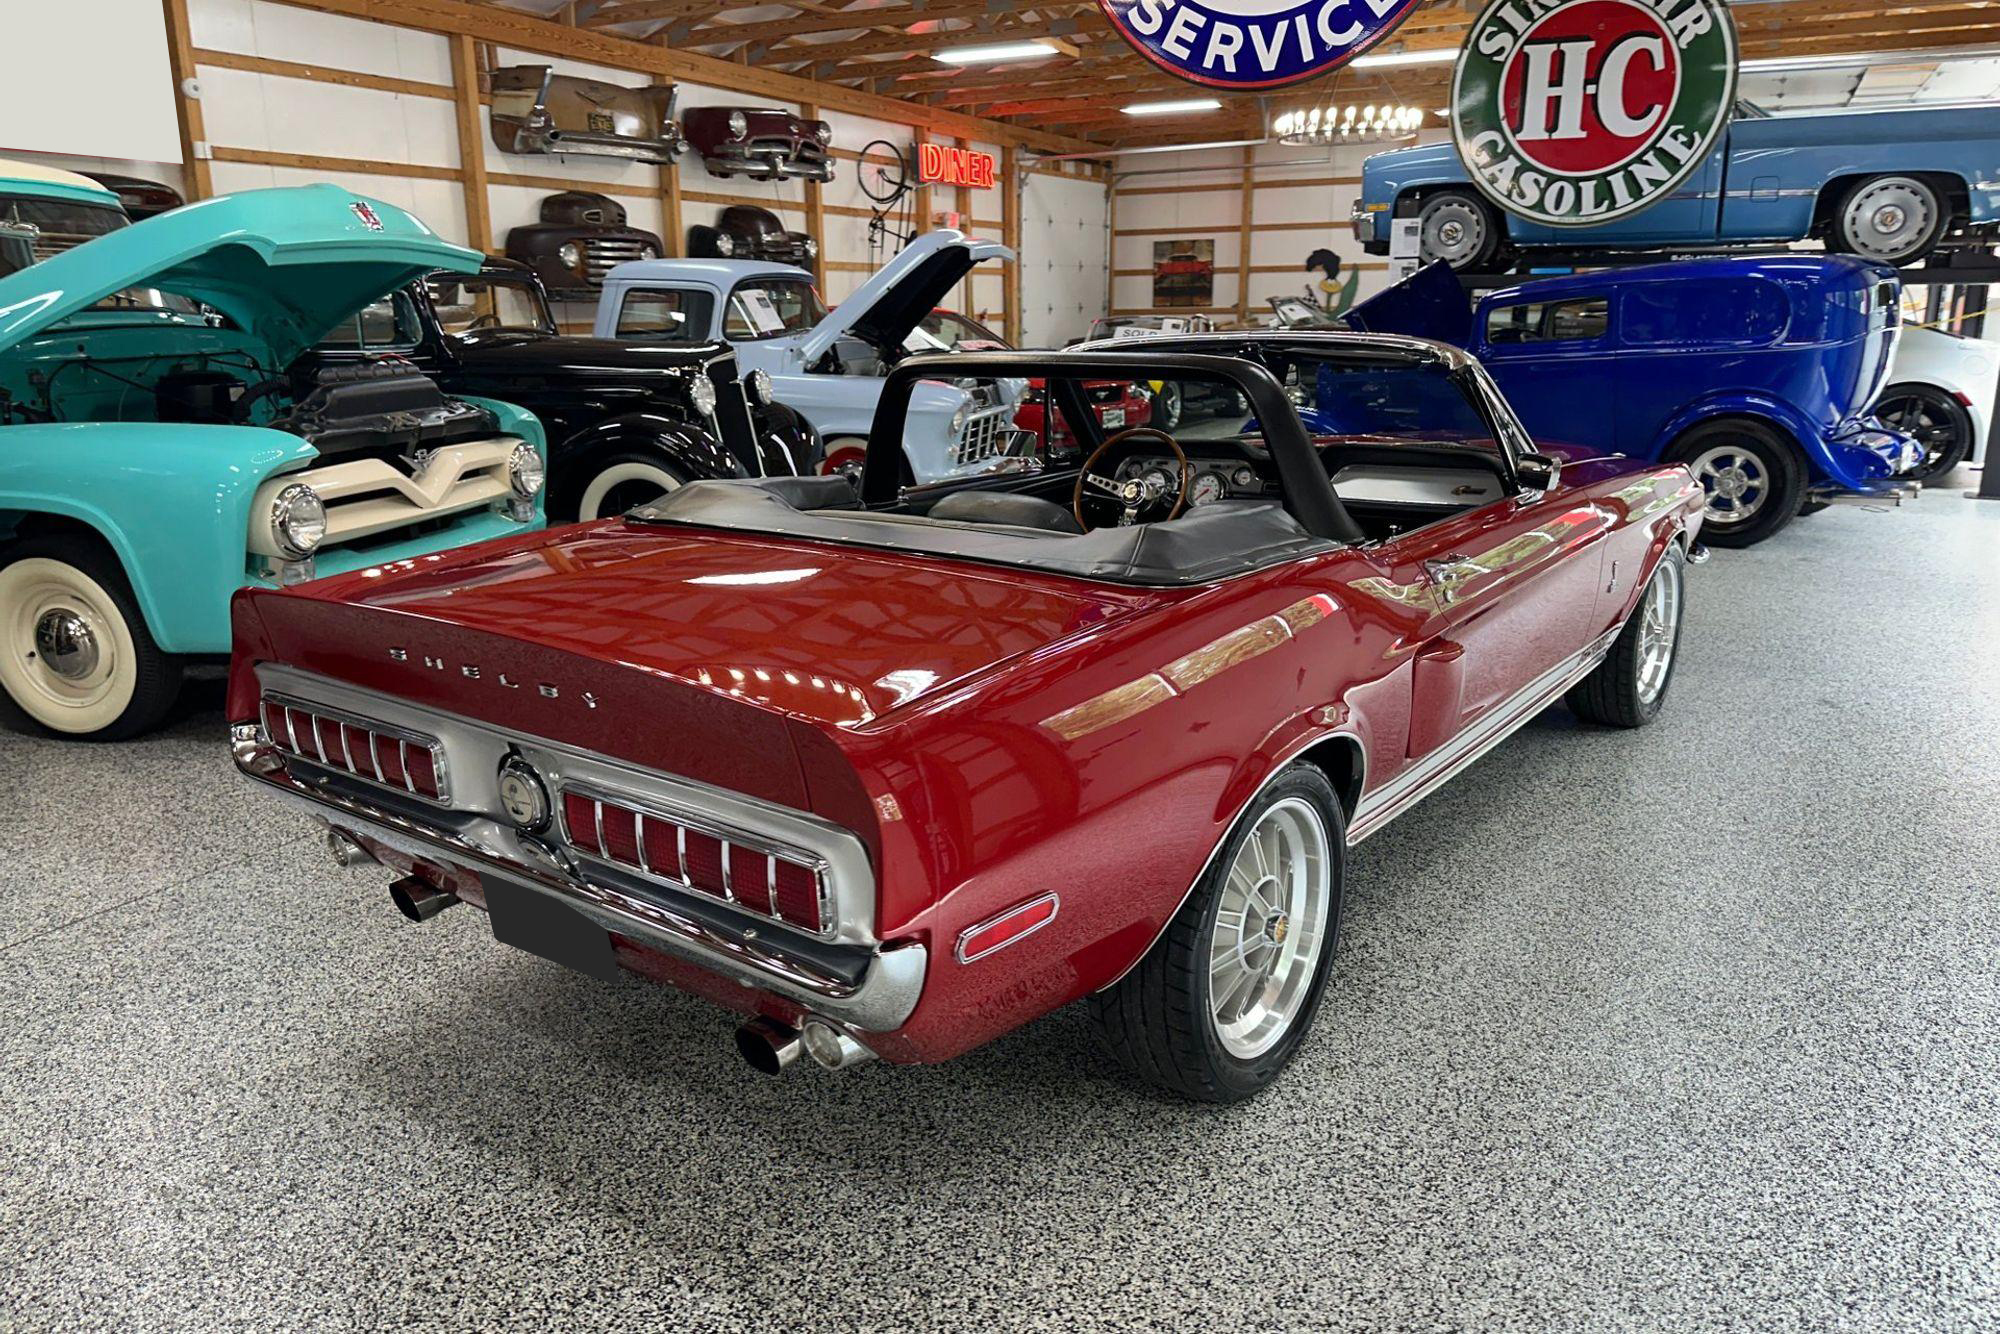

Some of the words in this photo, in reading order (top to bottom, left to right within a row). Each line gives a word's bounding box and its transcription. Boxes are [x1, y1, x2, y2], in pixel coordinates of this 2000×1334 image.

[921, 143, 996, 187] DINER
[1470, 124, 1702, 216] GASOLINE
[390, 648, 600, 708] SHELBY
